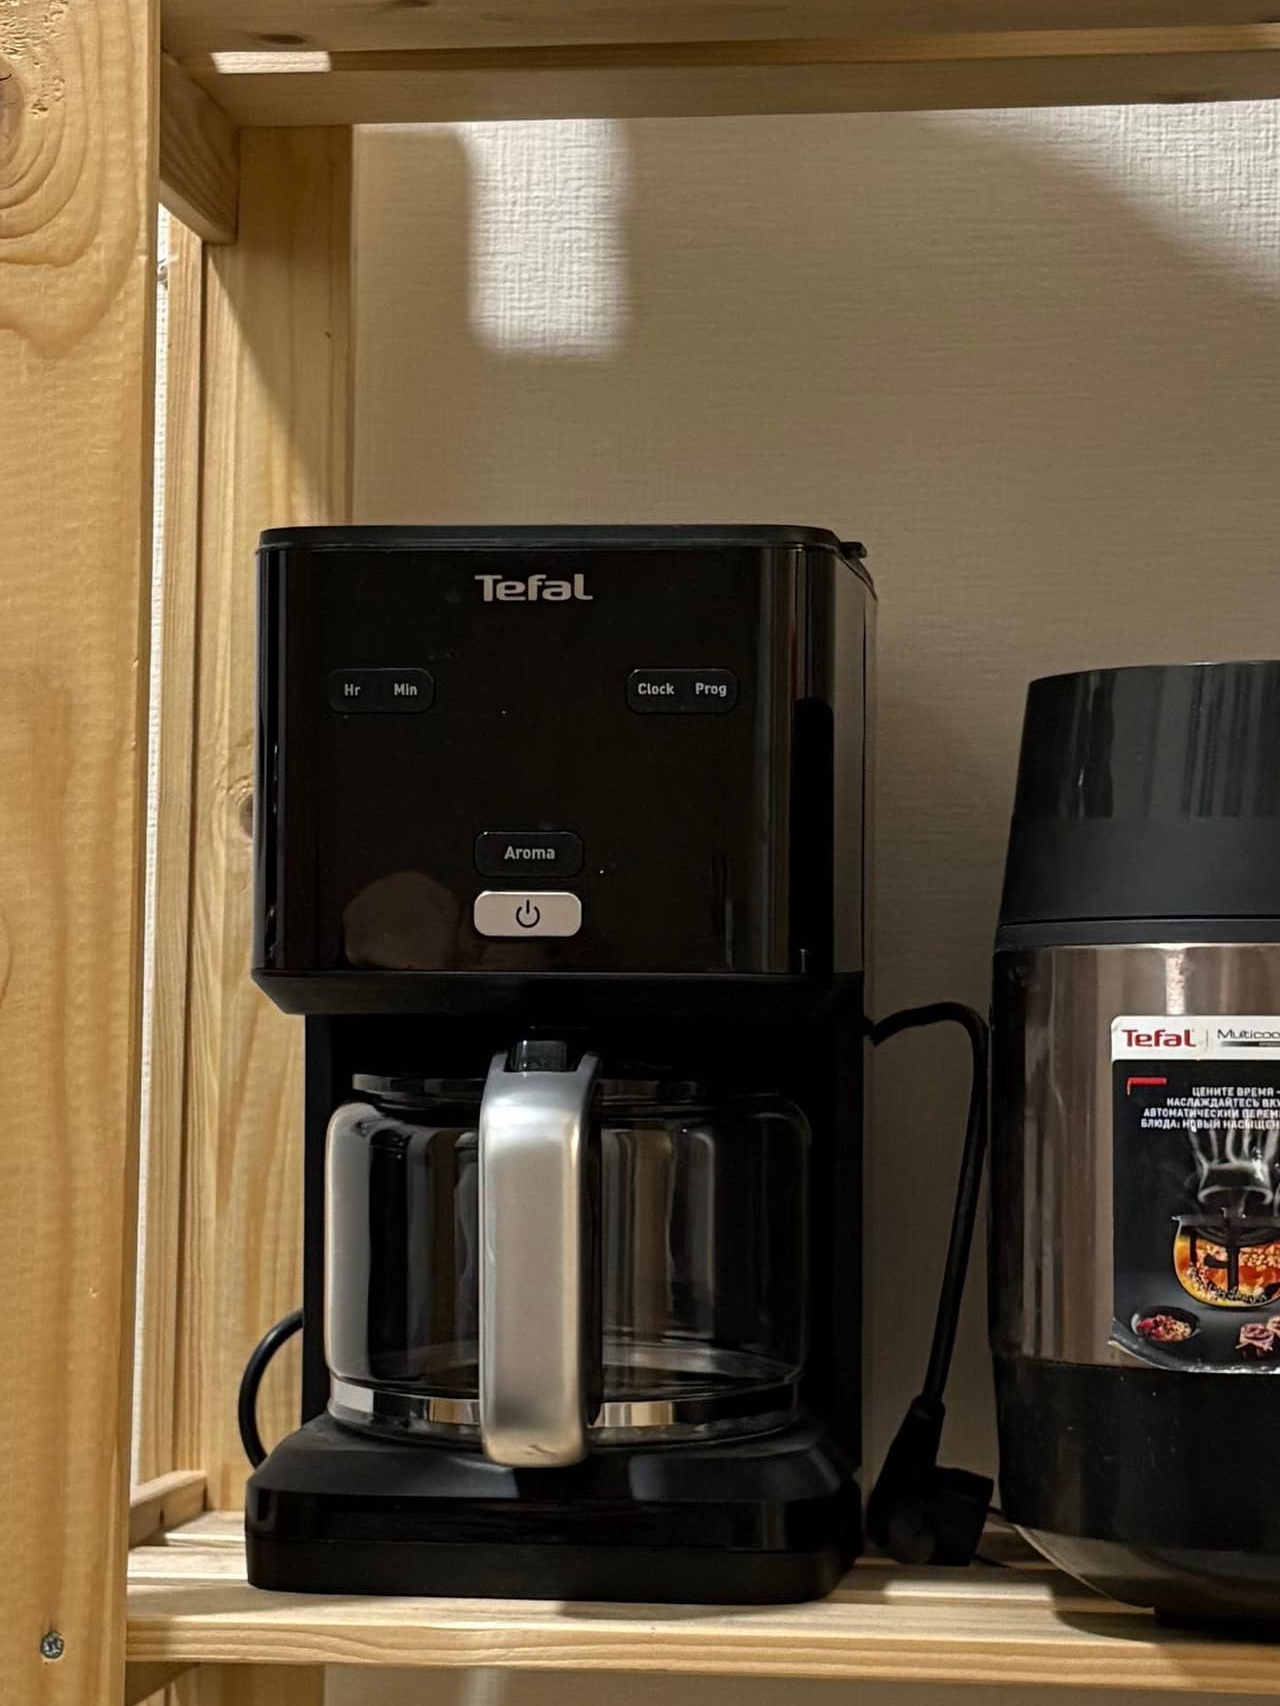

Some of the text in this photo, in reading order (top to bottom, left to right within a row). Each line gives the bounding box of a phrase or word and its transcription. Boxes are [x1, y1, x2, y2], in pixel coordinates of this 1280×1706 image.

[474, 573, 593, 602] Tefal
[344, 683, 418, 696] Hr Min
[637, 683, 727, 697] Clock Prog
[504, 845, 556, 860] Aroma
[1122, 1029, 1197, 1047] Tefal
[1192, 1087, 1234, 1097] ЦЕНИТЕ
[1237, 1087, 1274, 1097] ВРЕМЯ
[1167, 1097, 1259, 1108] НАСЛАЖДАЙТЕСЬ
[1183, 1118, 1220, 1129] НОВЫЙ
